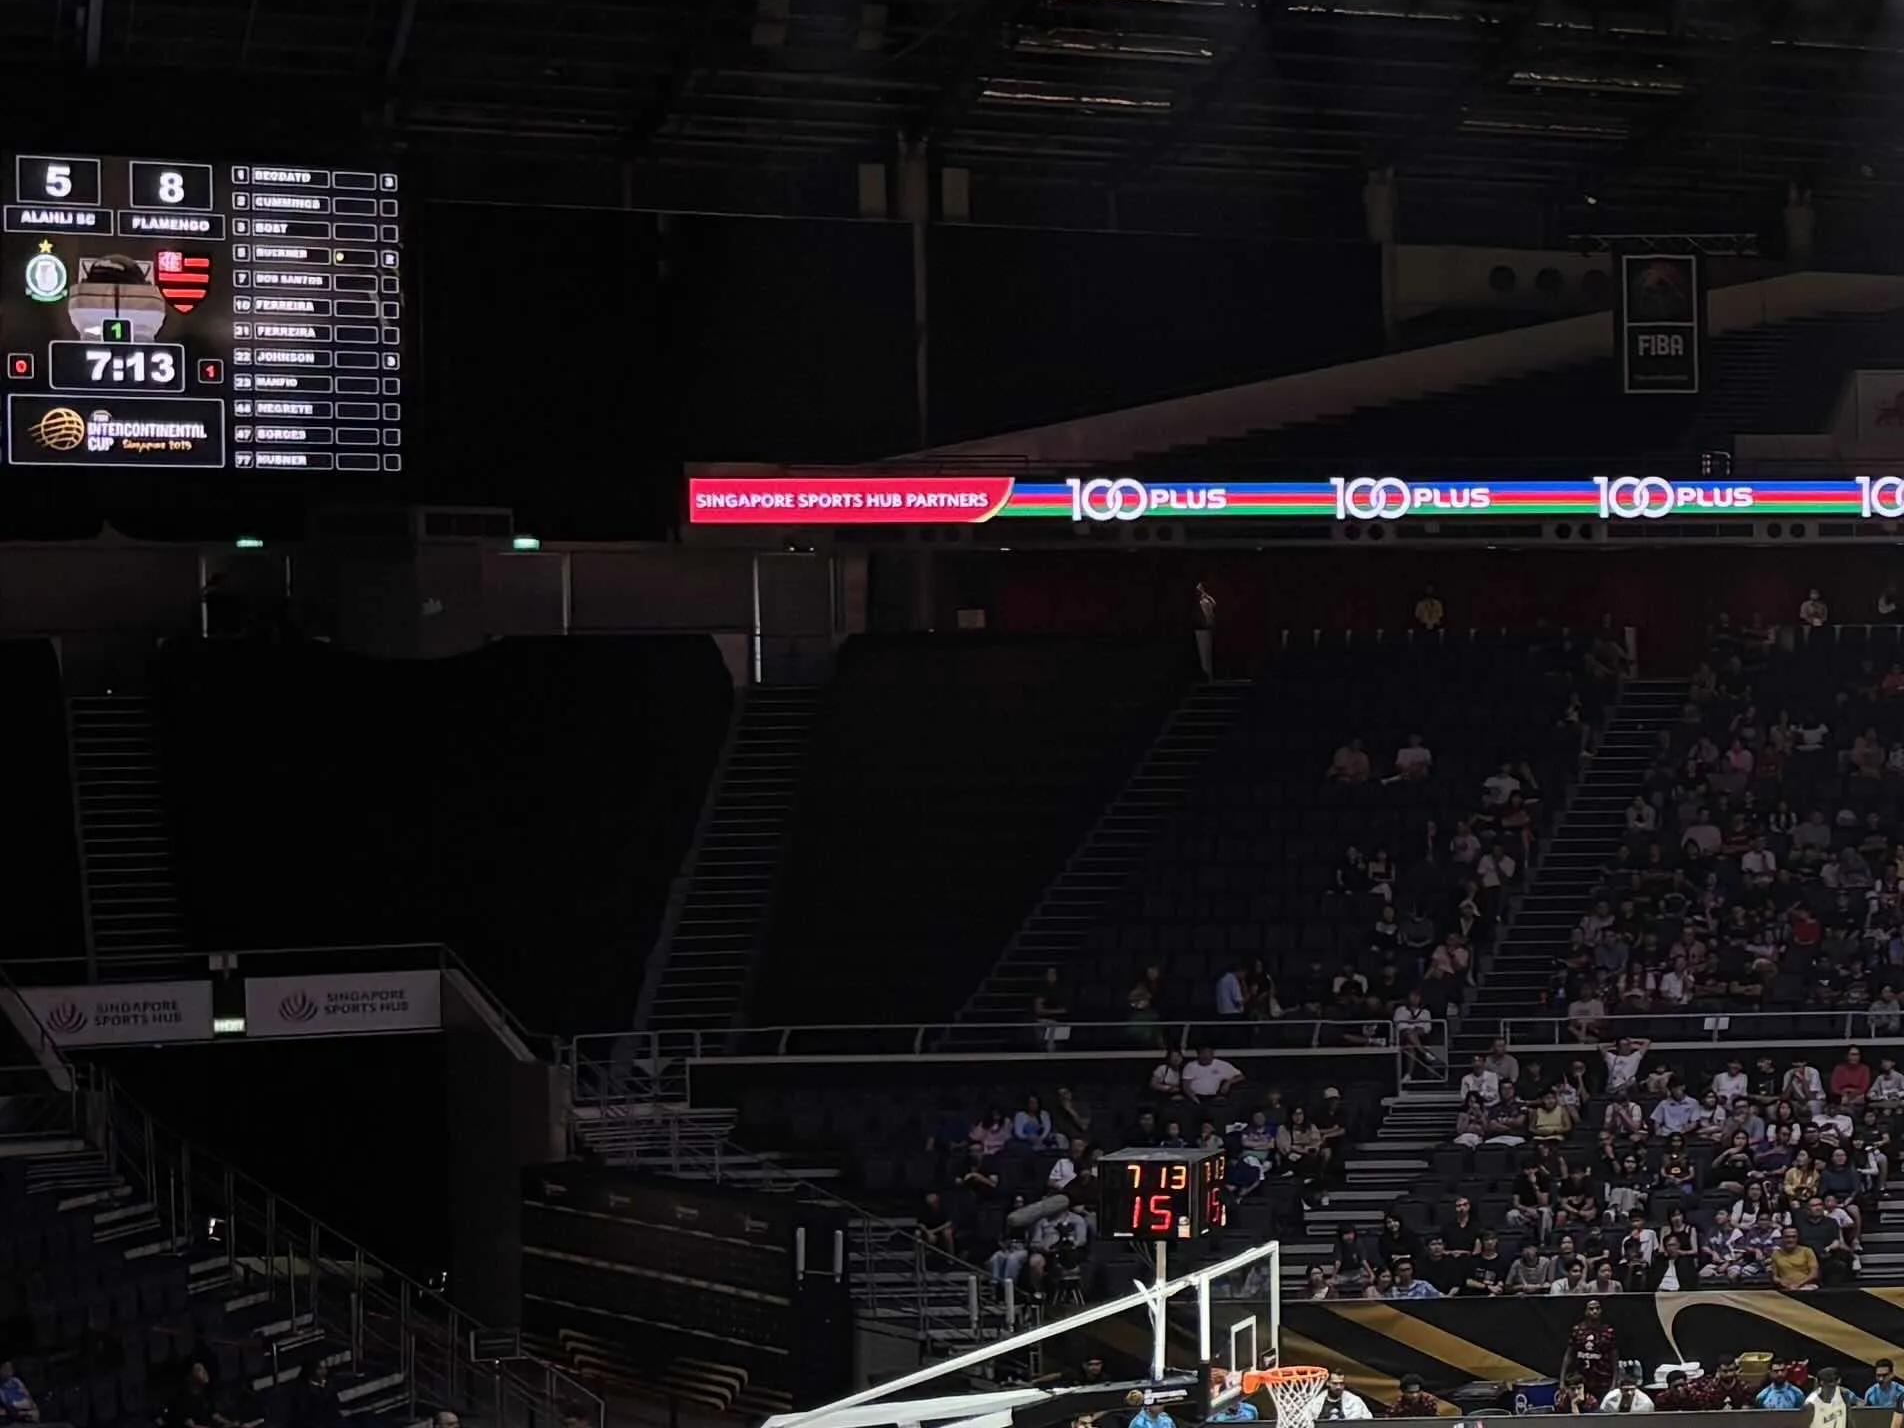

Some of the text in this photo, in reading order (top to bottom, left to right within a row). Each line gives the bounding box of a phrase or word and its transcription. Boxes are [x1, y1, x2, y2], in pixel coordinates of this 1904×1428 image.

[46, 166, 72, 197] 5
[158, 172, 185, 204] 8
[132, 216, 210, 233] FLAMENGO
[110, 322, 122, 339] 1
[1637, 334, 1685, 357] FIBA
[15, 359, 27, 374] 0
[86, 351, 175, 383] 7:13
[205, 364, 215, 378] 1
[88, 437, 115, 453] CUP
[696, 492, 988, 508] SINGAPORE SPORTS HUB PARTNERS
[326, 988, 407, 1003] SINGAPORE
[97, 1000, 180, 1015] SINGAPORE
[324, 998, 410, 1015] SPORTS HUB
[94, 1009, 182, 1027] SPORTS HUB
[1132, 1195, 1172, 1230] 15
